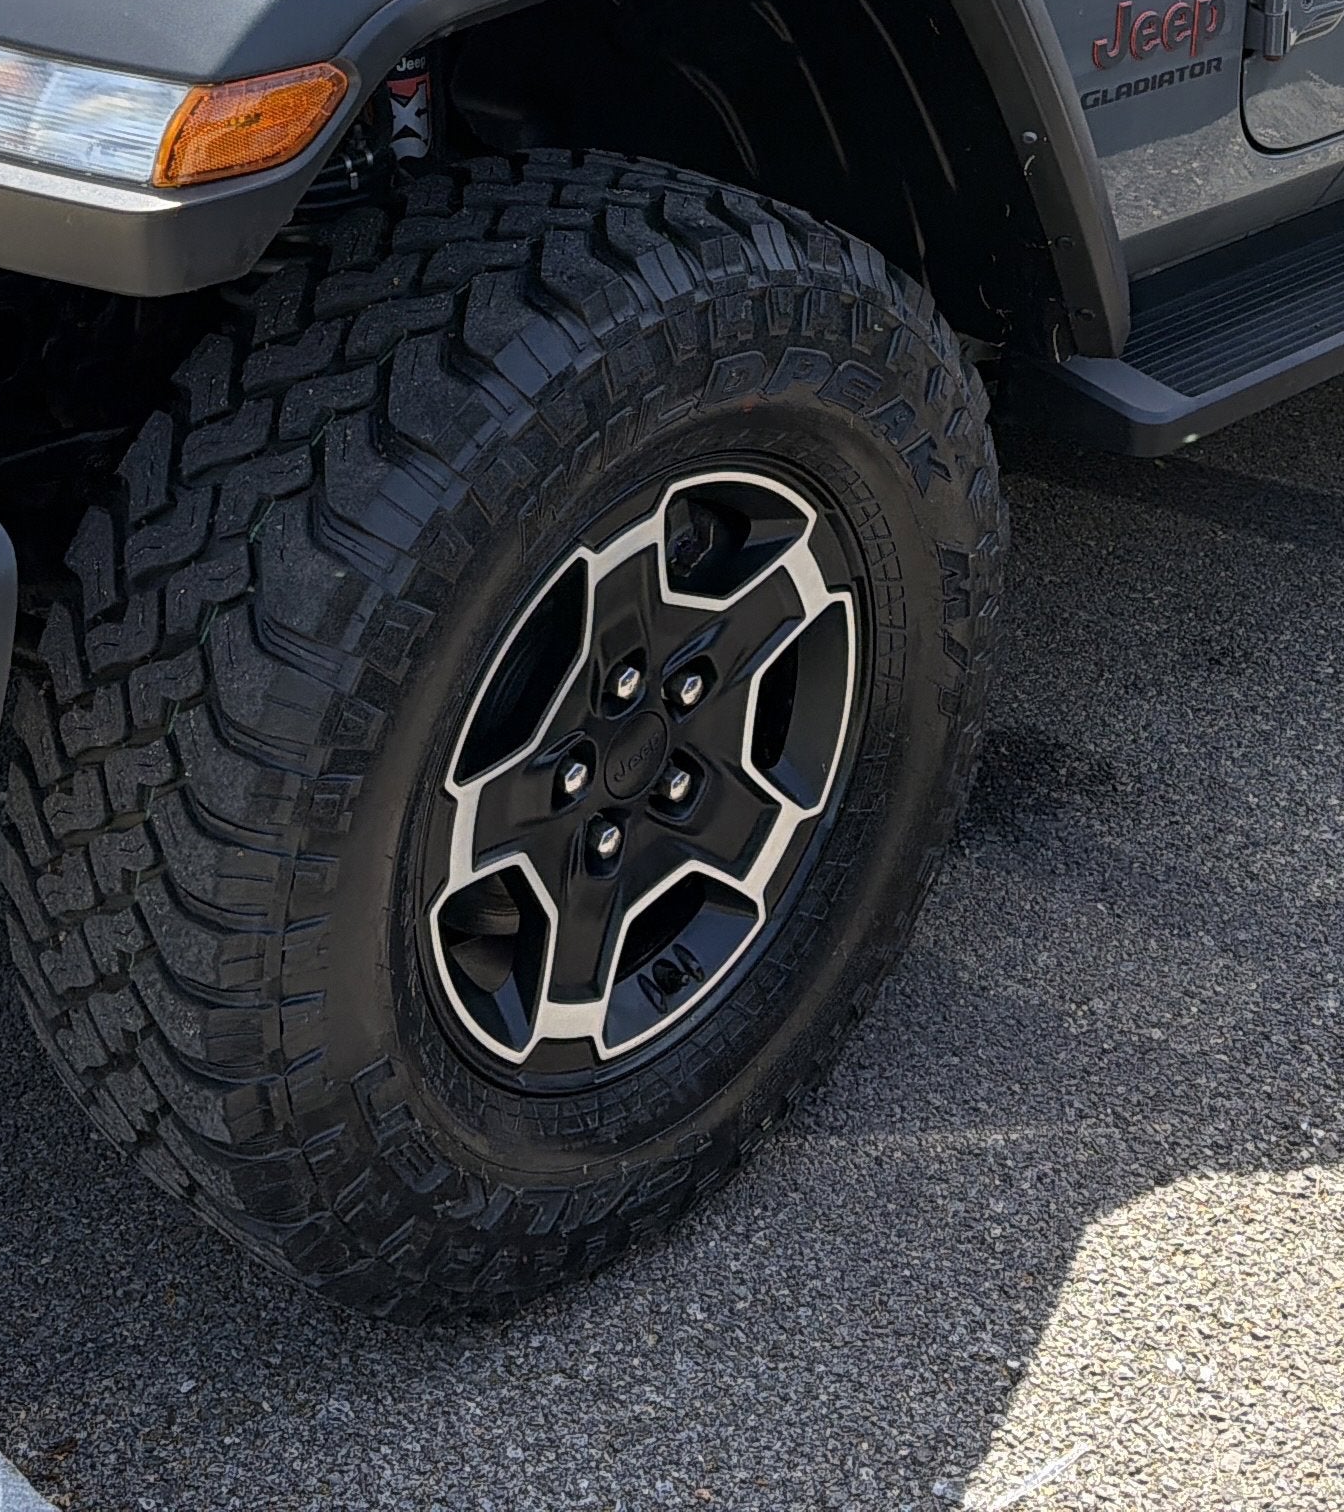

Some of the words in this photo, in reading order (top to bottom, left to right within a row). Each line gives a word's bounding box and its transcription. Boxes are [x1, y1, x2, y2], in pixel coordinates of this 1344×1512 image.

[396, 56, 426, 72] Jeep
[1080, 56, 1223, 110] GLADIATOR
[614, 733, 660, 783] Jeep
